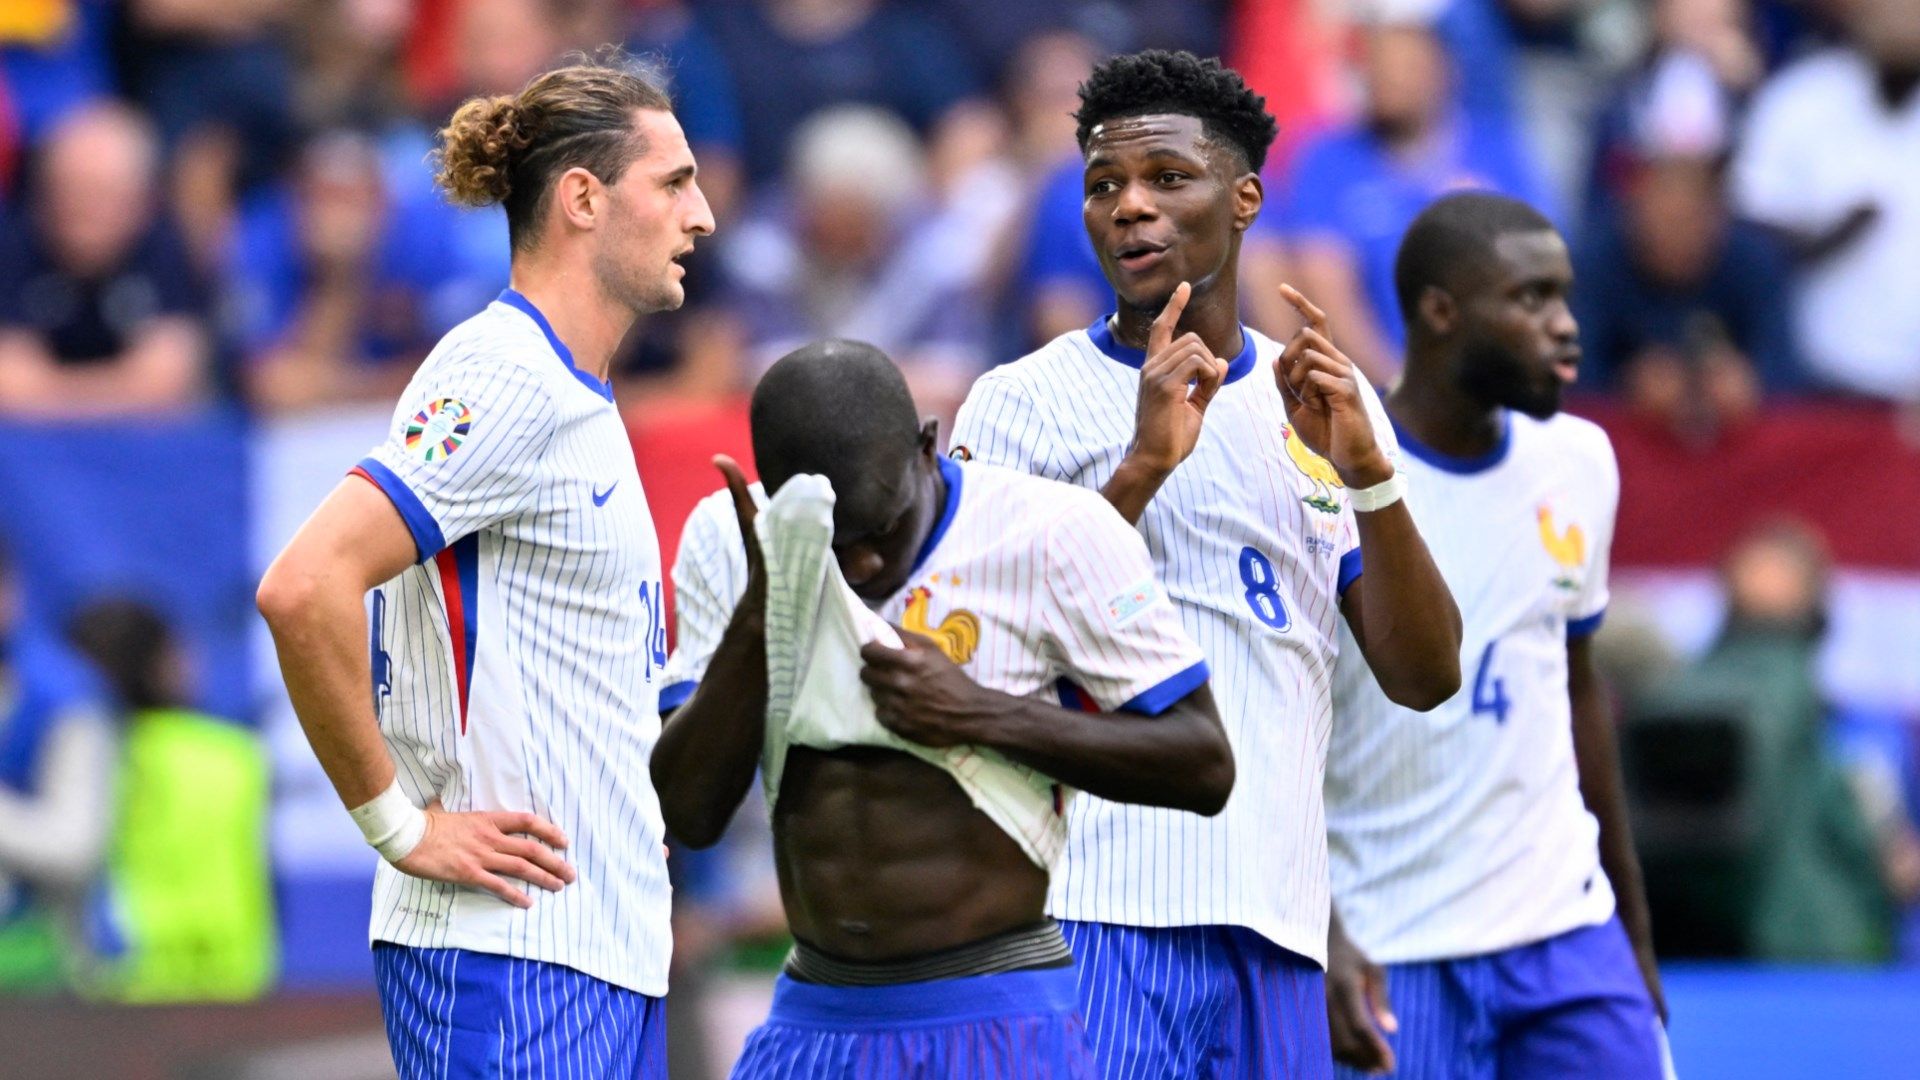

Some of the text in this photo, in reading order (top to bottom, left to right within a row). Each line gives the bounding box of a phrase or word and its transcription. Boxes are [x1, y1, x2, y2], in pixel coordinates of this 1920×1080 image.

[639, 580, 667, 683] 14
[1238, 545, 1292, 634] 8
[1471, 640, 1512, 726] 4
